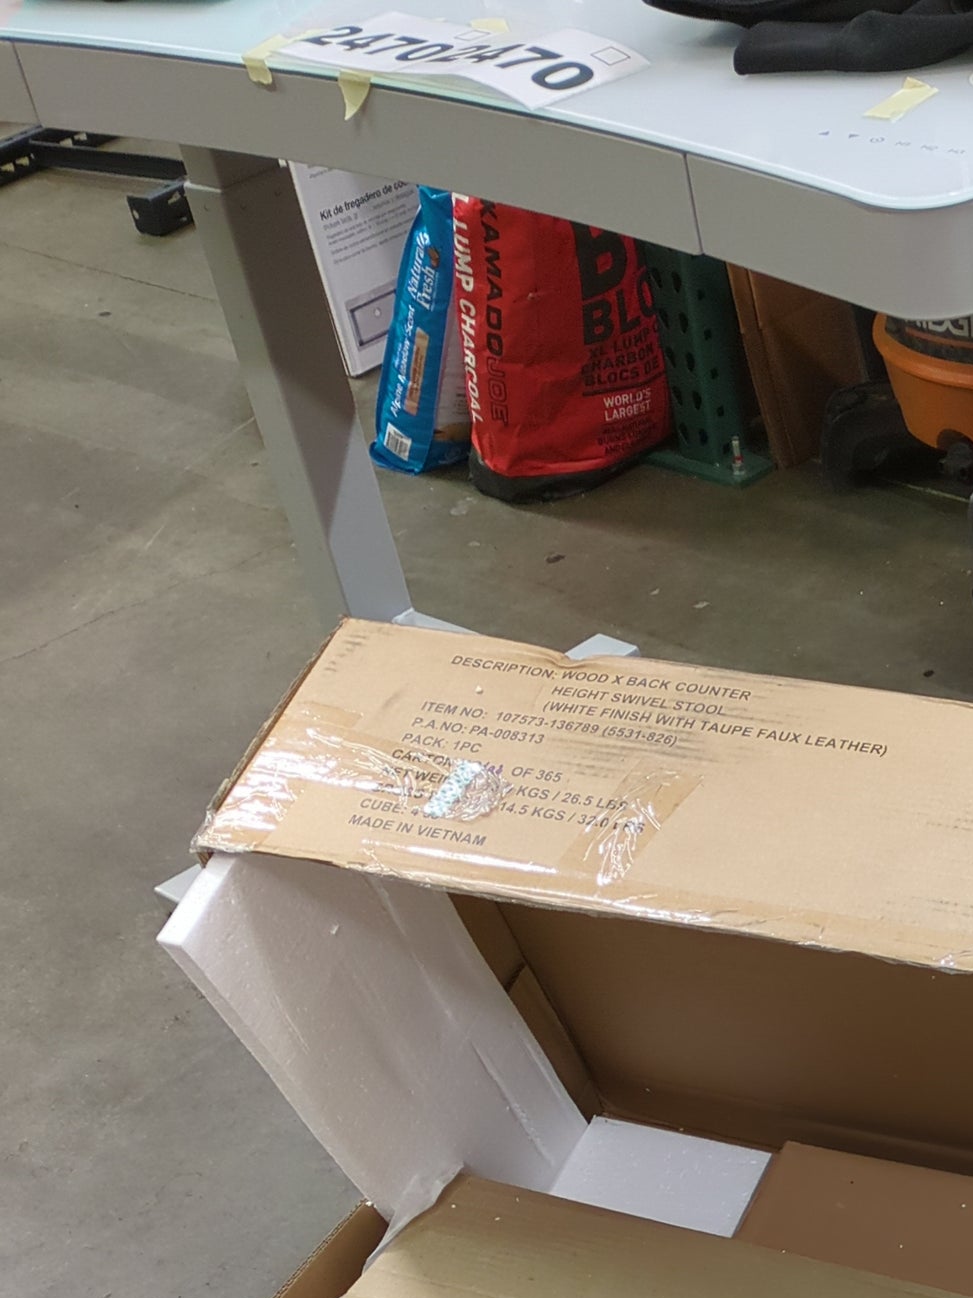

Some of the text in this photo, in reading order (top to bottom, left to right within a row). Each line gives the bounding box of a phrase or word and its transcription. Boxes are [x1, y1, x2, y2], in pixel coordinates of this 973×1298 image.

[302, 25, 454, 62] 2470
[432, 43, 594, 91] 2470
[320, 208, 332, 221] Kit
[334, 203, 344, 216] de
[344, 188, 381, 211] fregadero
[382, 182, 393, 196] de
[453, 222, 474, 292] LUMP
[415, 265, 437, 311] Fresh
[403, 305, 416, 336] Scent
[613, 327, 650, 357] LUMP
[396, 337, 412, 385] Meadow
[459, 299, 484, 424] CHARCOAL
[581, 343, 654, 377] CHARBON
[583, 354, 660, 388] BLOCS DE
[390, 380, 404, 418] Alpine
[603, 388, 652, 409] WORLD'S
[604, 399, 652, 423] LARGEST
[451, 655, 752, 701] DESCRIPTION: WOOD X BACK COUNTER
[551, 685, 726, 716] HEIGHT SWIVEL STOOL
[411, 716, 545, 744] P.A.NO: PA-008313
[421, 700, 678, 748] ITEM NO: 107573-136789 (5531-826)
[542, 700, 889, 758] (WHITE FINISH WITH TAUPE FAUX LEATHER)
[401, 733, 483, 753] PACK: 1PC
[511, 766, 534, 778] OF
[535, 769, 563, 783] 365
[359, 797, 408, 815] CUBE:
[516, 785, 550, 801] KGS
[561, 792, 594, 807] 26.5
[348, 814, 488, 847] MADE IN VIETNAM
[499, 801, 529, 815] 14.5
[531, 807, 567, 823] KGS
[577, 814, 609, 829] 32.0
